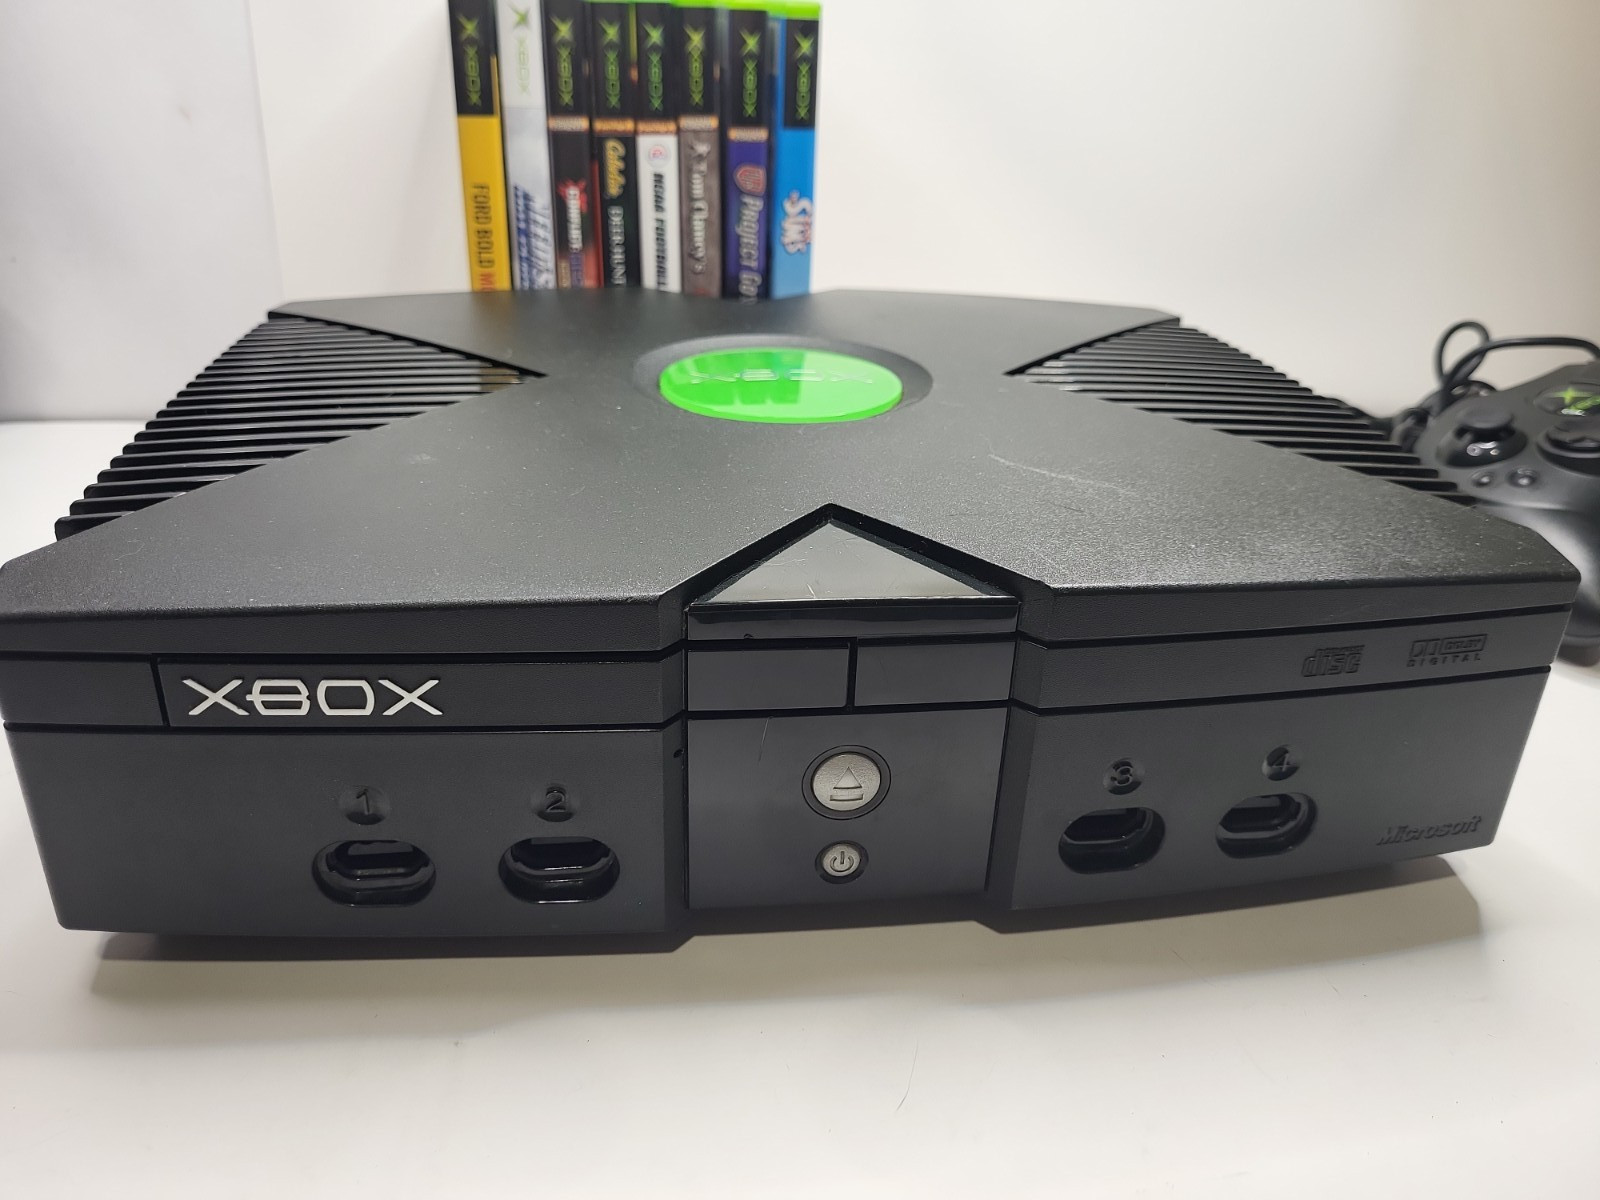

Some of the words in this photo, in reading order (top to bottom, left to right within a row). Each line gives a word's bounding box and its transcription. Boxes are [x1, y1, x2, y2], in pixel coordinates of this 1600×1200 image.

[464, 45, 481, 106] XBOX
[556, 47, 574, 108] XBOX
[605, 50, 621, 109] XBOX
[647, 53, 663, 111] XBOX
[688, 48, 704, 107] XBOX
[742, 60, 757, 117] XBOX
[796, 61, 811, 120] XBOX
[473, 183, 492, 225] FORD
[476, 228, 496, 268] BOLD
[689, 368, 873, 384] XBOX
[1407, 653, 1481, 668] DIGITAL
[181, 678, 443, 716] XBOX
[356, 788, 370, 815] 1
[545, 786, 567, 813] 2
[1376, 815, 1482, 846] Microsoft
